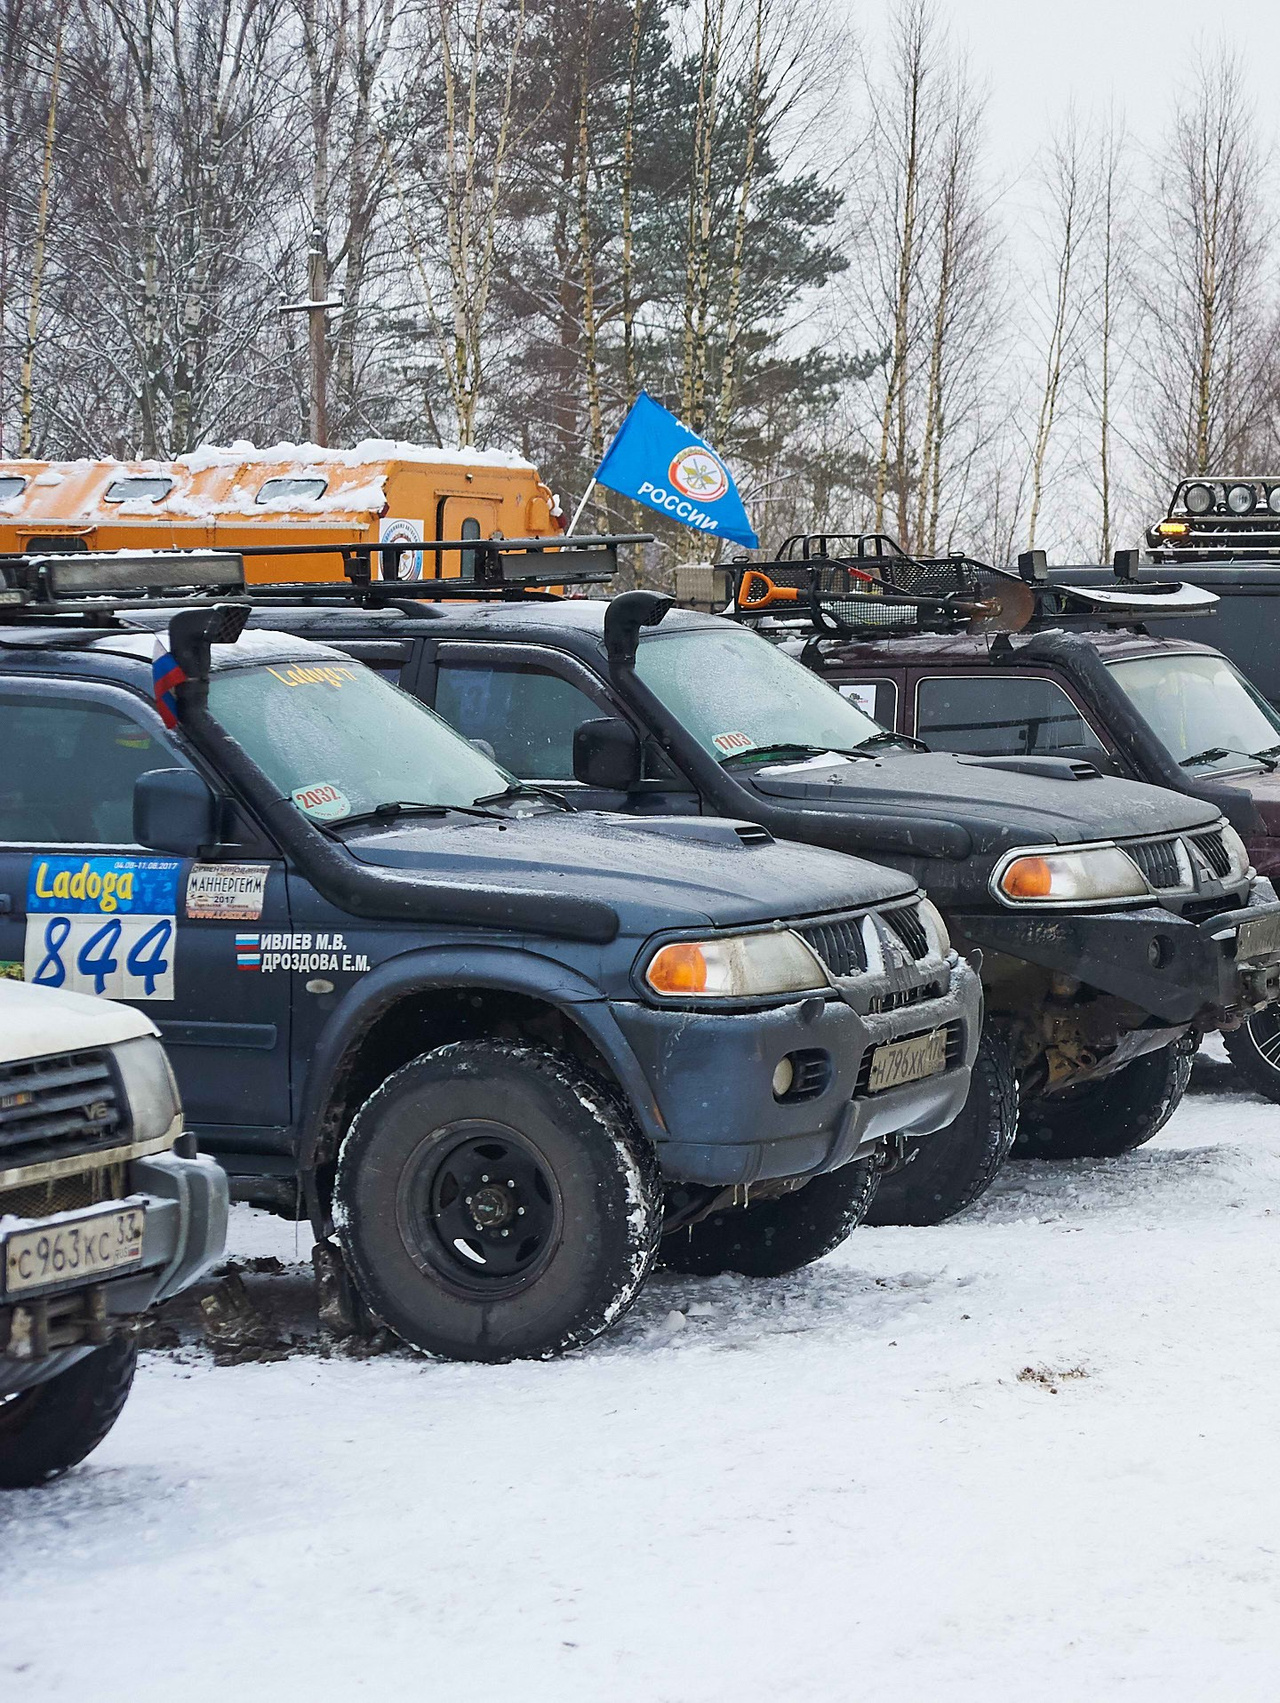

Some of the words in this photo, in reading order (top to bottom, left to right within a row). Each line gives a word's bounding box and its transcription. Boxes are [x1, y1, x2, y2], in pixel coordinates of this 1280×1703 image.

[637, 481, 719, 531] РОССИИ
[715, 733, 752, 750] 1703
[296, 786, 341, 809] 2032
[35, 862, 134, 912] Ladoga
[189, 875, 262, 893] МАННЕРГЕЙМ
[214, 896, 235, 904] 2017
[260, 933, 312, 951] ИВЛЕВ
[315, 933, 347, 951] М.В.
[32, 916, 172, 996] 844
[261, 953, 339, 973] ДРОЗДОВА
[342, 954, 371, 972] Е.М.
[82, 1101, 108, 1120] V6
[117, 1212, 137, 1245] 33
